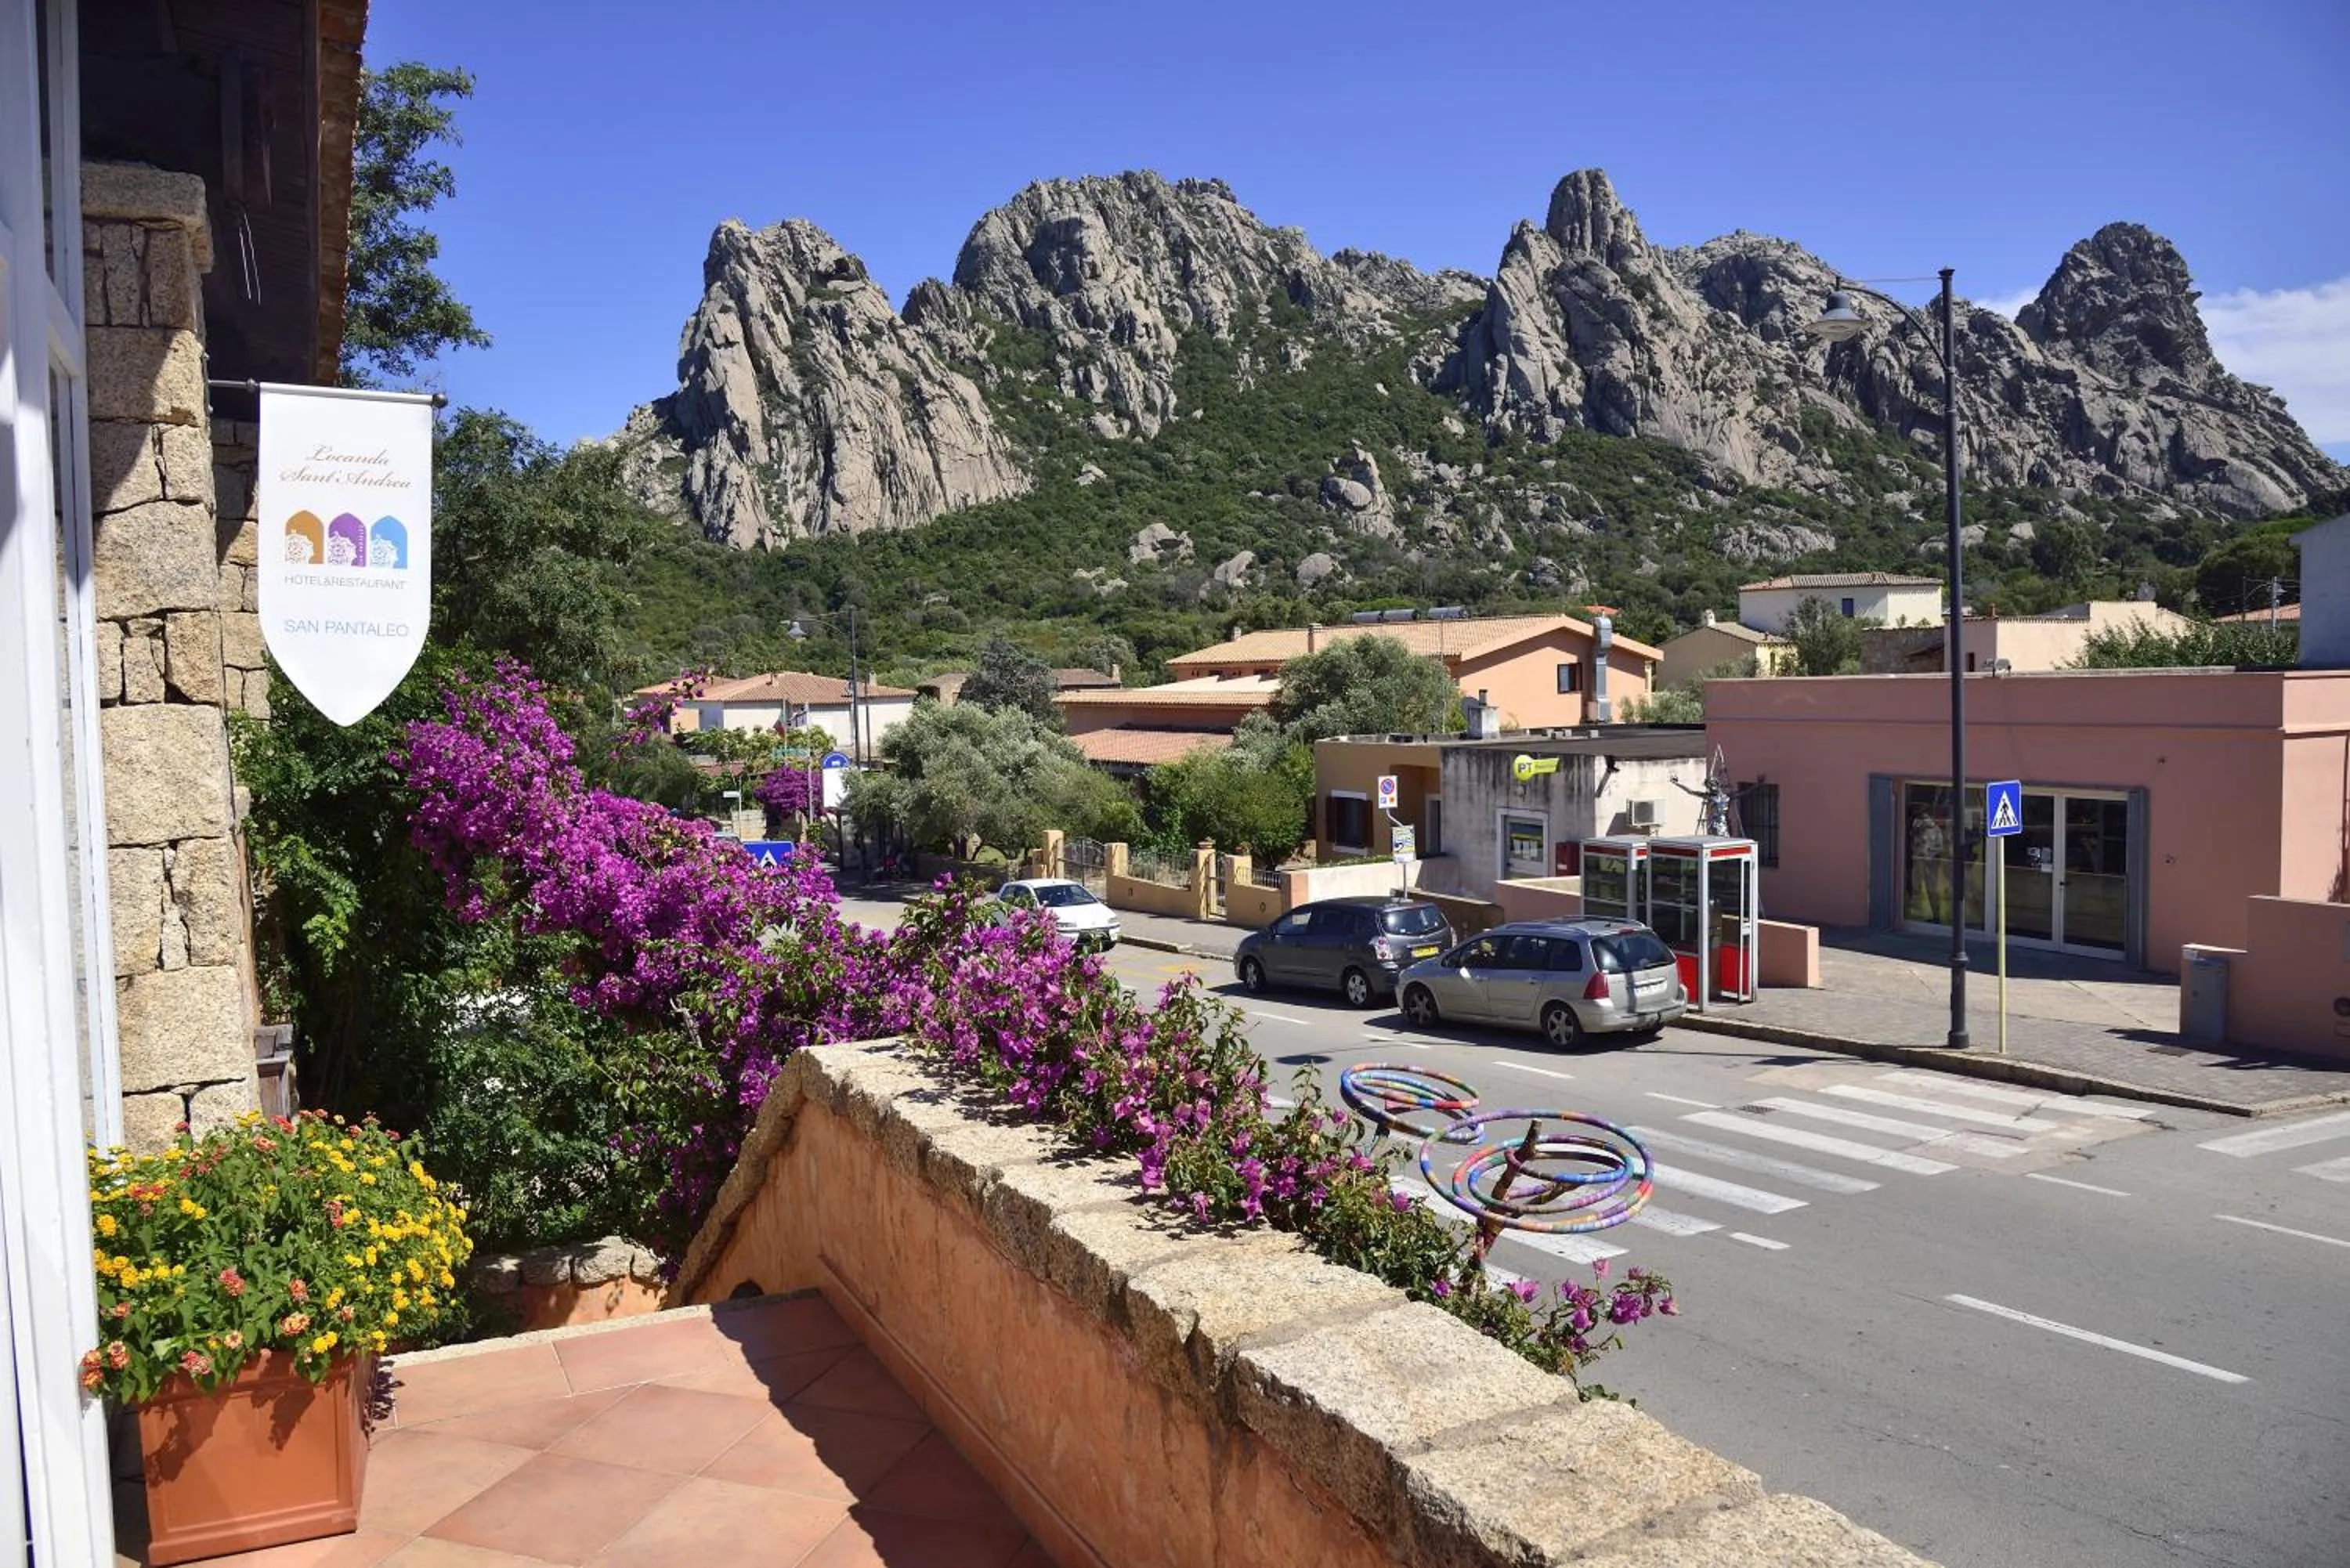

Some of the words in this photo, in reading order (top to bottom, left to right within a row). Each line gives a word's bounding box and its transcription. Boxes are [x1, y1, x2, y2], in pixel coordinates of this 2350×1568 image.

[306, 443, 390, 465] Locanda
[279, 464, 414, 489] Sant'Andrea
[284, 575, 408, 590] HOTEL&RESTAURANT
[284, 619, 320, 634] SAN
[325, 620, 409, 638] PANTALEO
[1518, 762, 1532, 773] PT
